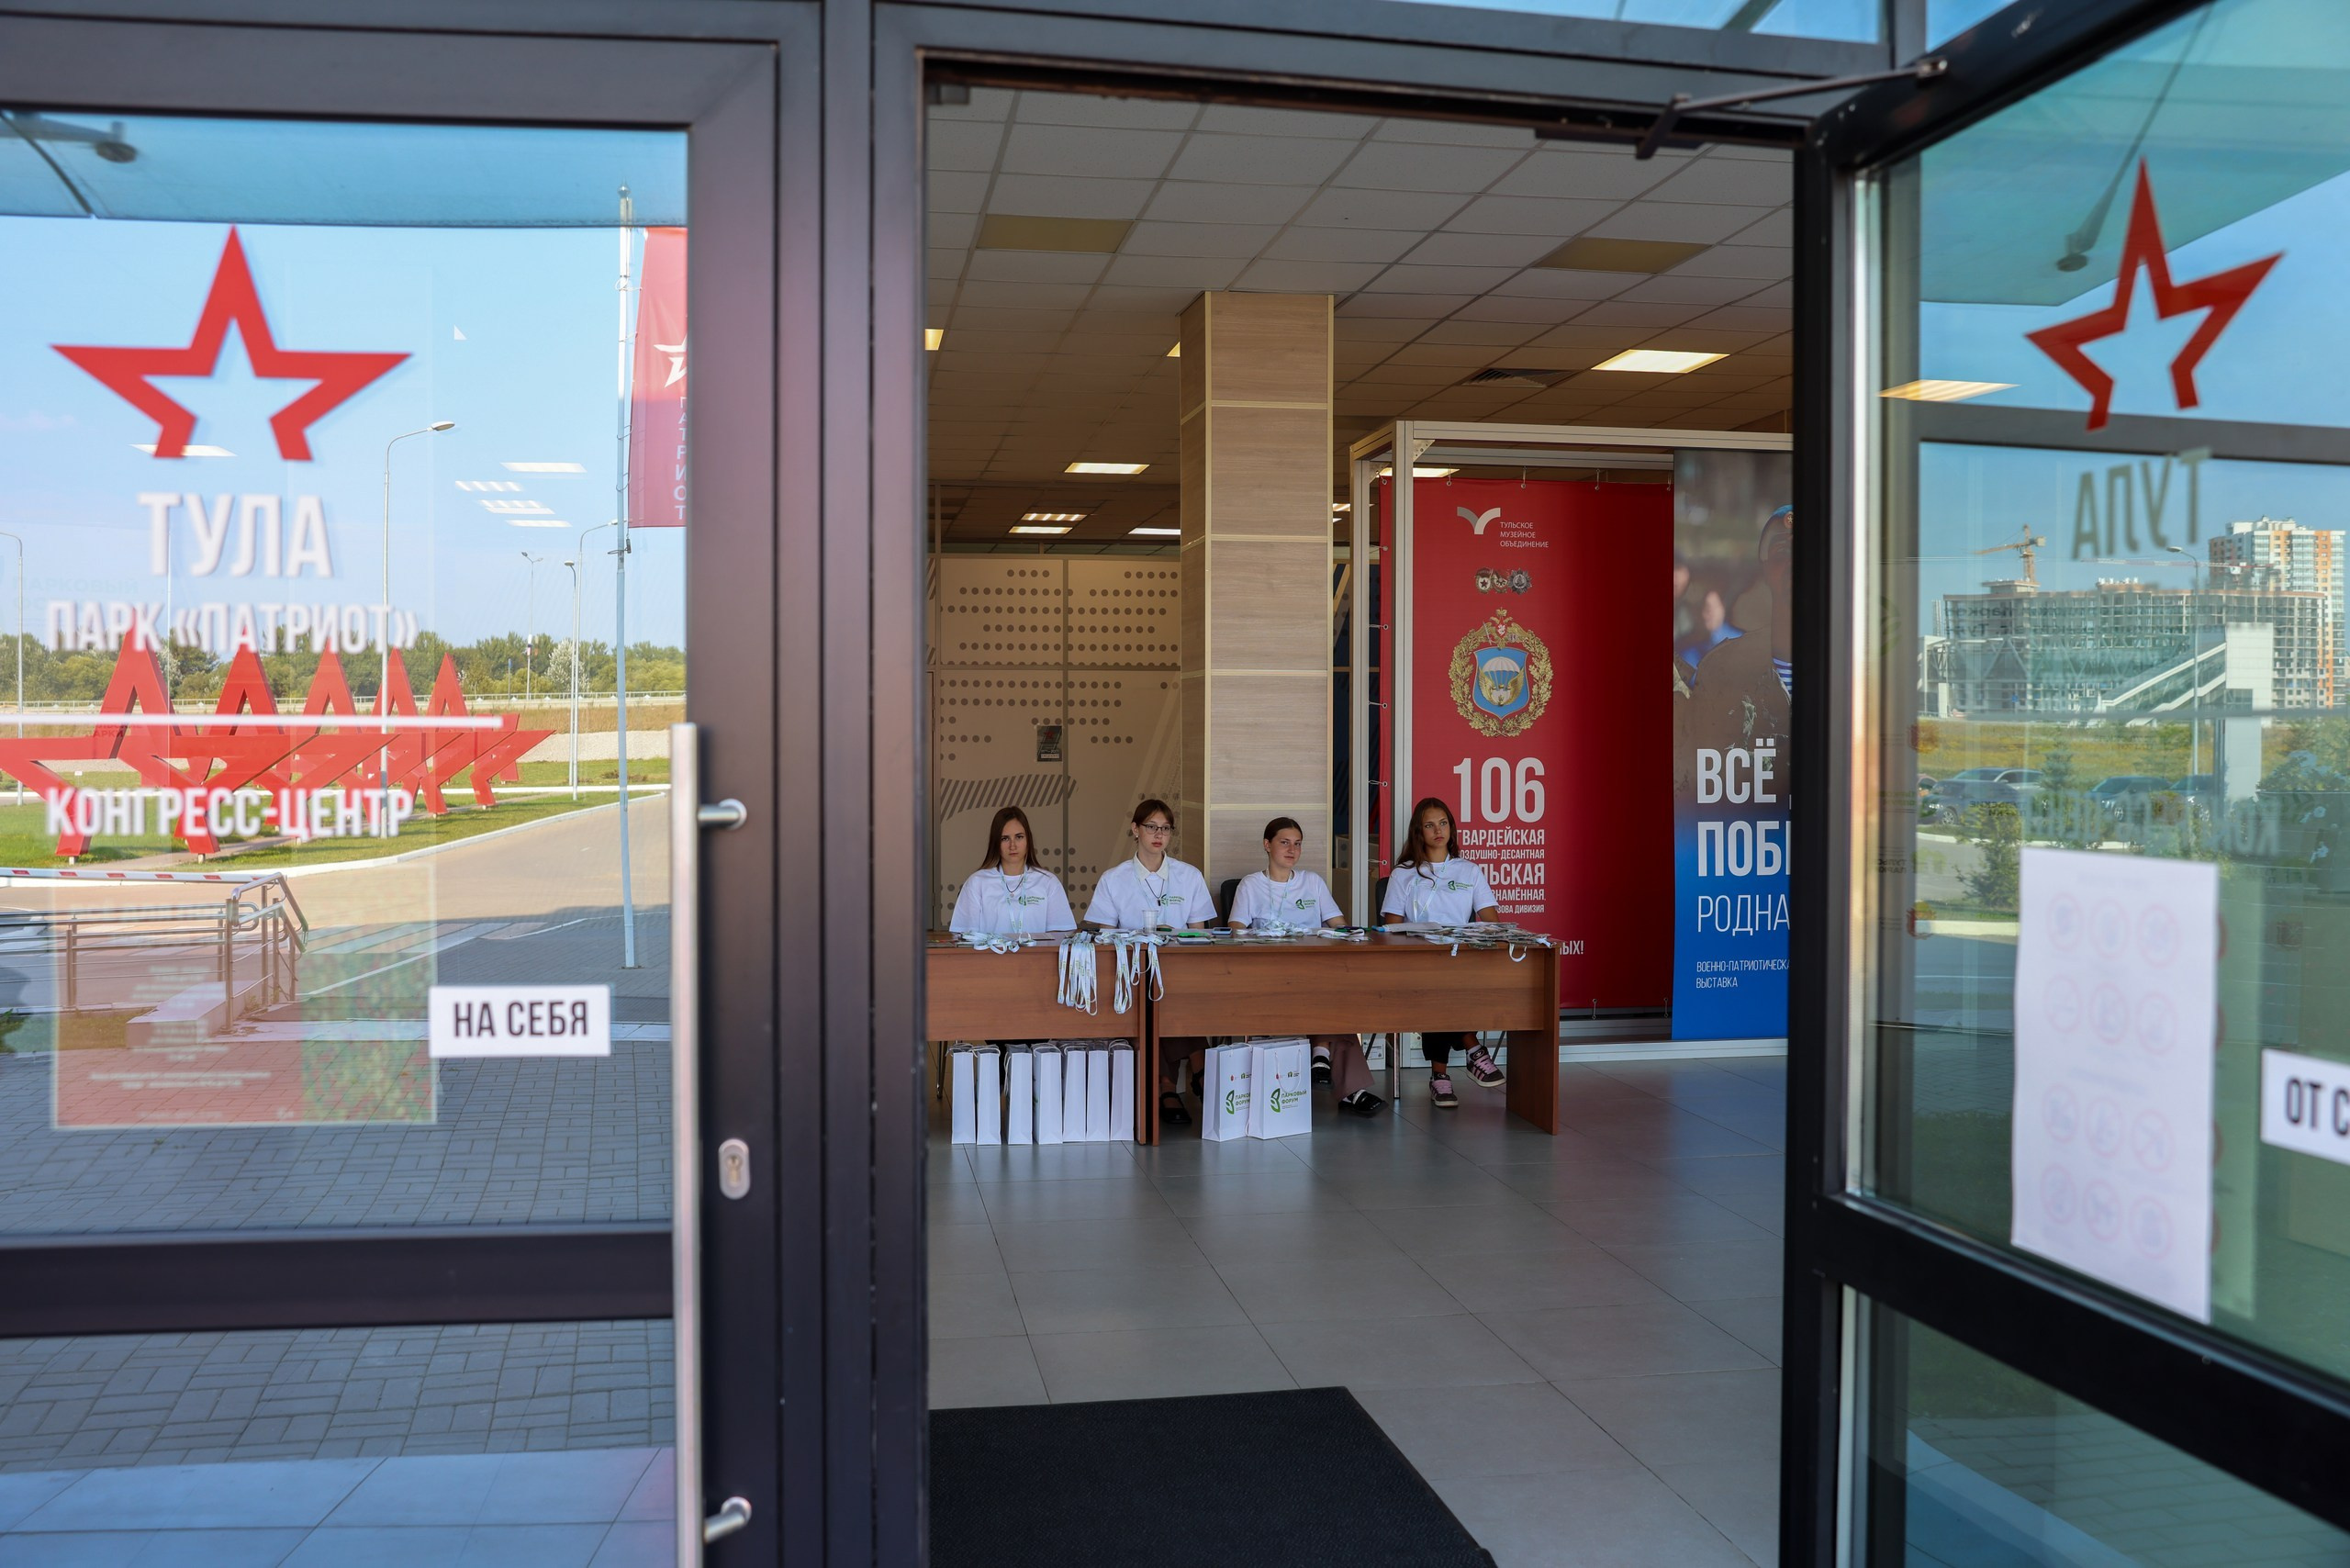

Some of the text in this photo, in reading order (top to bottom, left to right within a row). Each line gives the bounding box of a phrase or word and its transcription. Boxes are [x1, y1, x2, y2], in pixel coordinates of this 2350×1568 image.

[138, 493, 333, 578] ТУЛА
[1500, 521, 1534, 530] ТУЛЬСКОЕ
[1500, 531, 1536, 539] МУЗЕЙНОЕ
[1500, 540, 1549, 549] ОБЪЕДИНЕНИЕ
[46, 602, 420, 655] ПАРК «ПАТРИОТ»
[1696, 738, 1777, 804] ВСЁ
[1453, 756, 1545, 823] 106
[46, 787, 414, 843] КОНГРЕСС-ЦЕНТР
[1459, 849, 1545, 860] ОЗДУШНО-ДЕСАНТНАЯ
[1479, 863, 1545, 885] ЛЬСКАЯ
[1497, 904, 1545, 914] ЗОВА ДИВИЗИЯ
[1696, 892, 1791, 936] РОДНА
[1560, 940, 1584, 956] ЫХ!
[1695, 977, 1739, 989] ВЫСТАВКА
[453, 1000, 589, 1038] НА СЕБЯ
[1281, 1089, 1307, 1098] ПАРКОВЫЙ
[2286, 1077, 2322, 1130] ОТ
